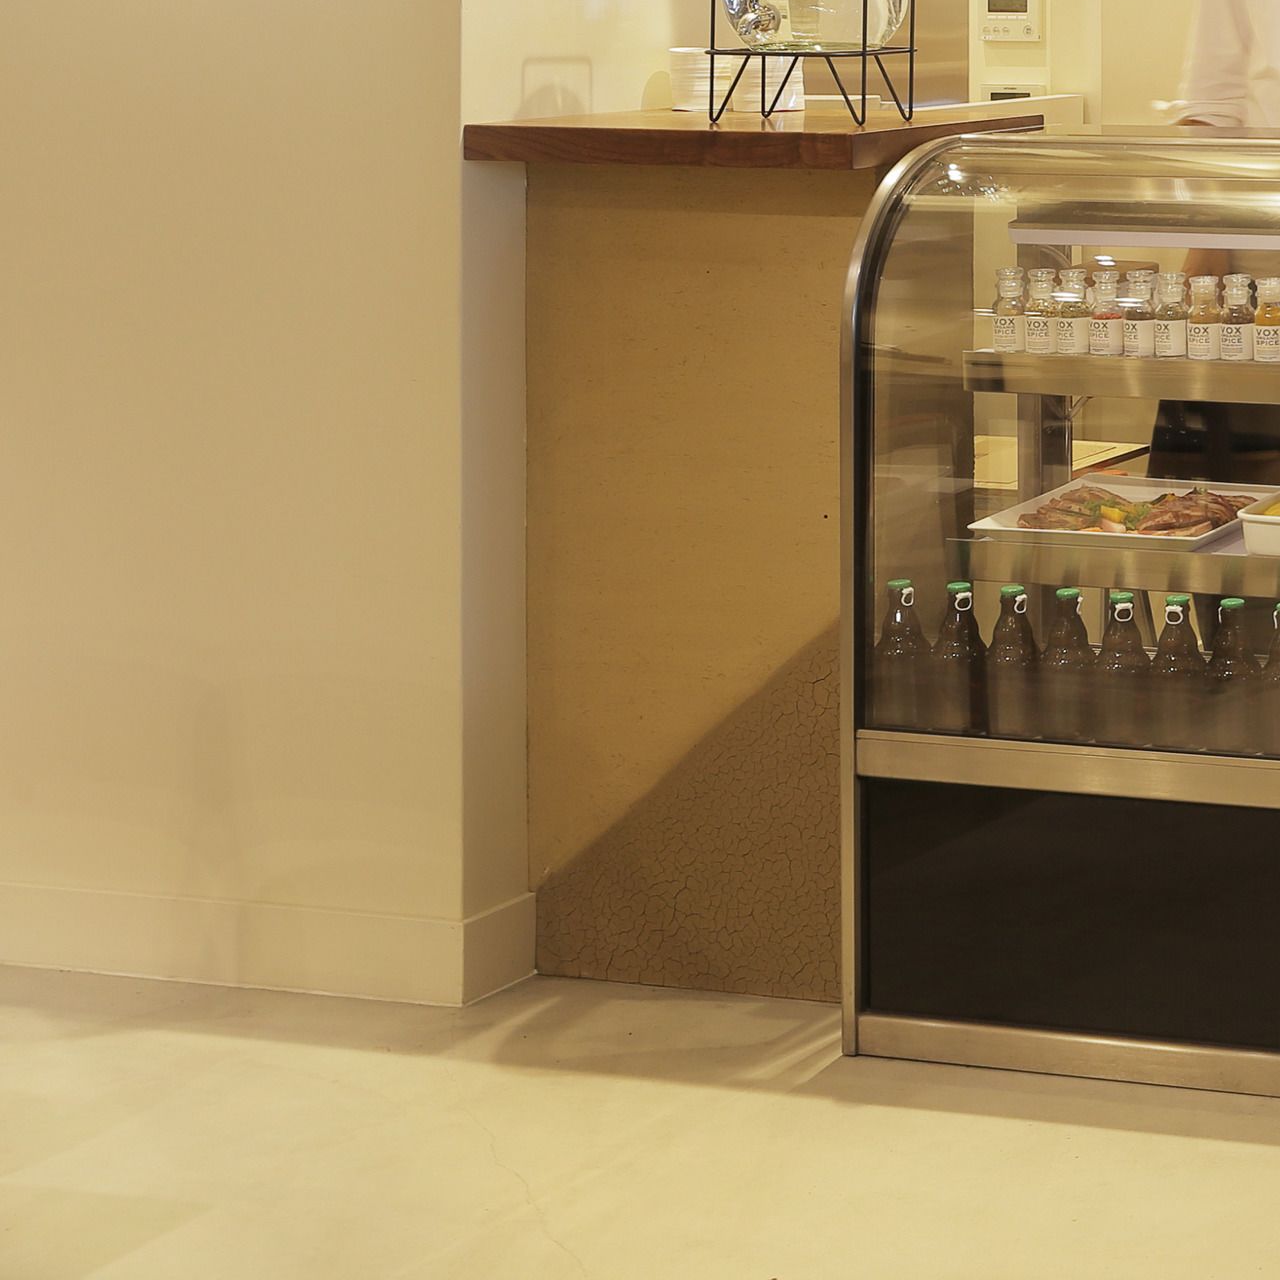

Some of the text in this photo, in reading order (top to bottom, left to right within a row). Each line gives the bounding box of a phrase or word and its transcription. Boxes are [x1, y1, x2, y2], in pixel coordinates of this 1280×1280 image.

[993, 317, 1015, 326] VOX
[1027, 320, 1049, 329] VOX
[1124, 323, 1138, 331] OX
[1156, 323, 1169, 332] OX
[1256, 329, 1279, 337] VOX
